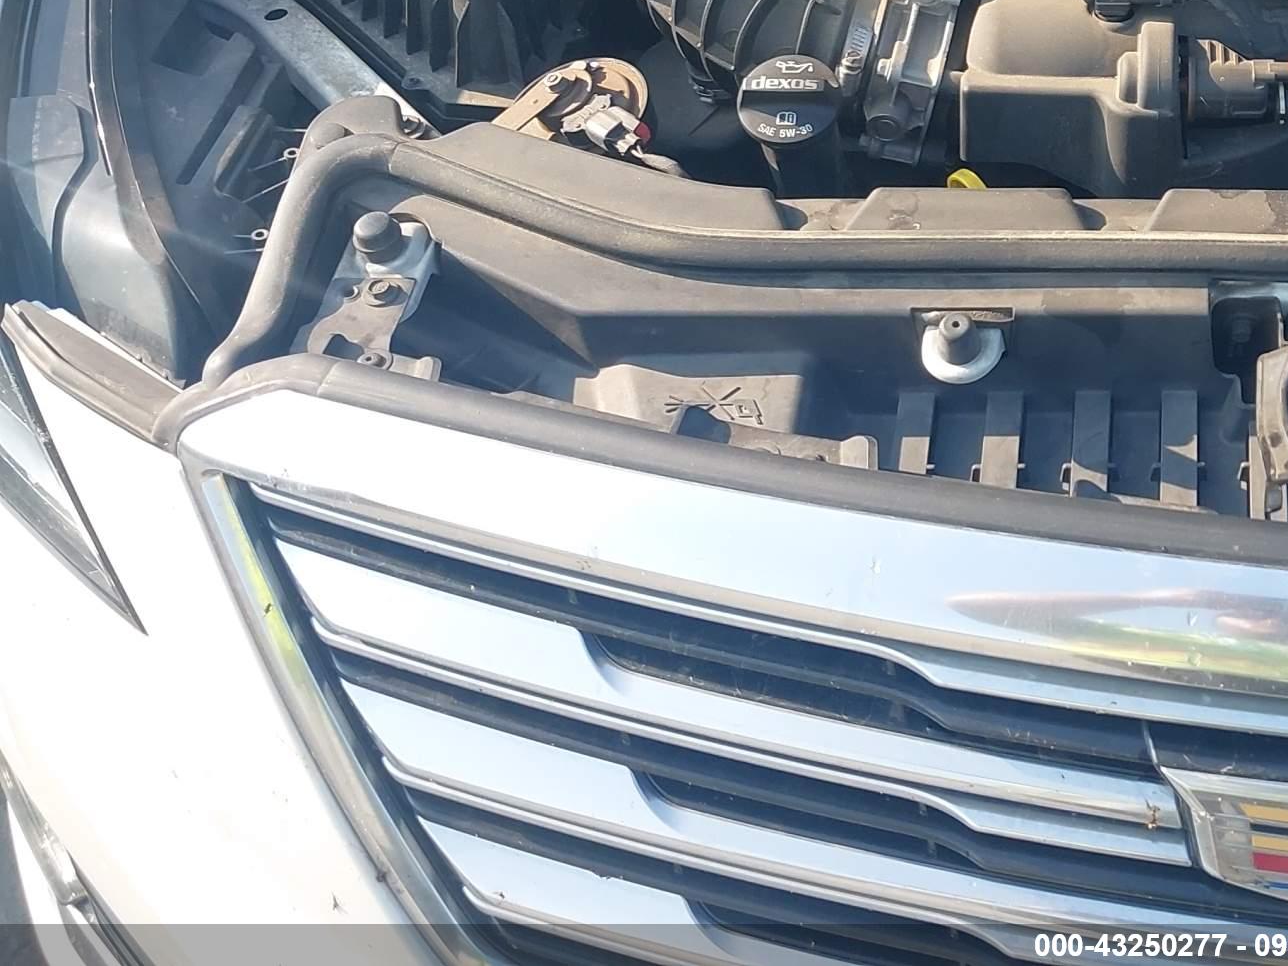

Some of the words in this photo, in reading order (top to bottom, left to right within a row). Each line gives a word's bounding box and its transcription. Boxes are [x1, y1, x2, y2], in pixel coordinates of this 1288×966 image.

[751, 75, 818, 90] dexos
[757, 123, 777, 137] SAE
[779, 123, 813, 138] 5W-30
